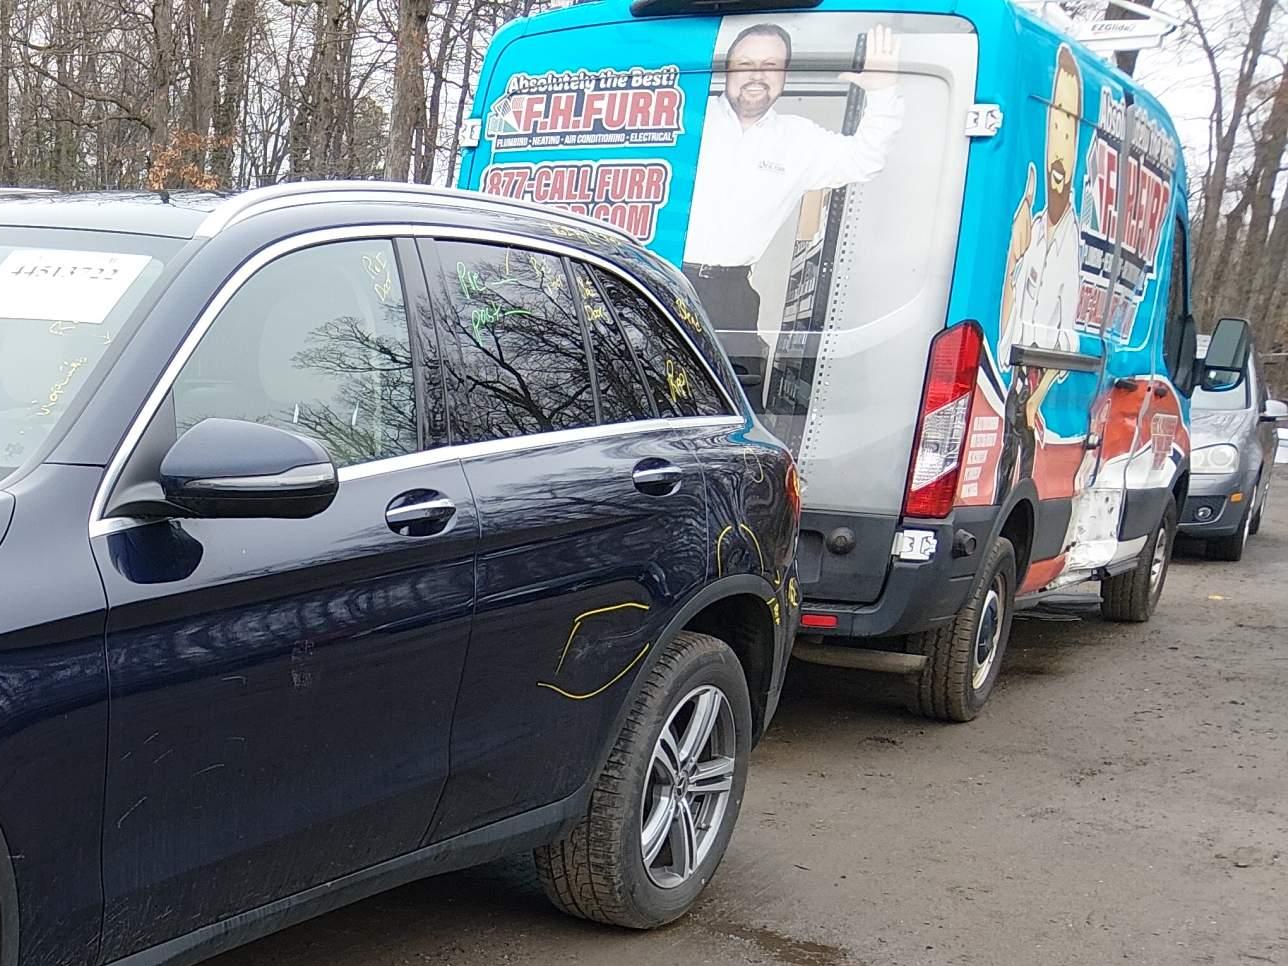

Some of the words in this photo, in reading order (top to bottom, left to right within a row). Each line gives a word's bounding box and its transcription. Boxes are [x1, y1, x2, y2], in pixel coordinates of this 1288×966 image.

[508, 71, 597, 94] Absolutely
[597, 69, 629, 89] the
[631, 66, 677, 87] Best!
[523, 90, 679, 132] F.H.FURR
[564, 135, 576, 145] AIR
[630, 132, 673, 143] ELECTRICAL
[487, 168, 593, 202] 877-CALL
[596, 167, 664, 201] FURR
